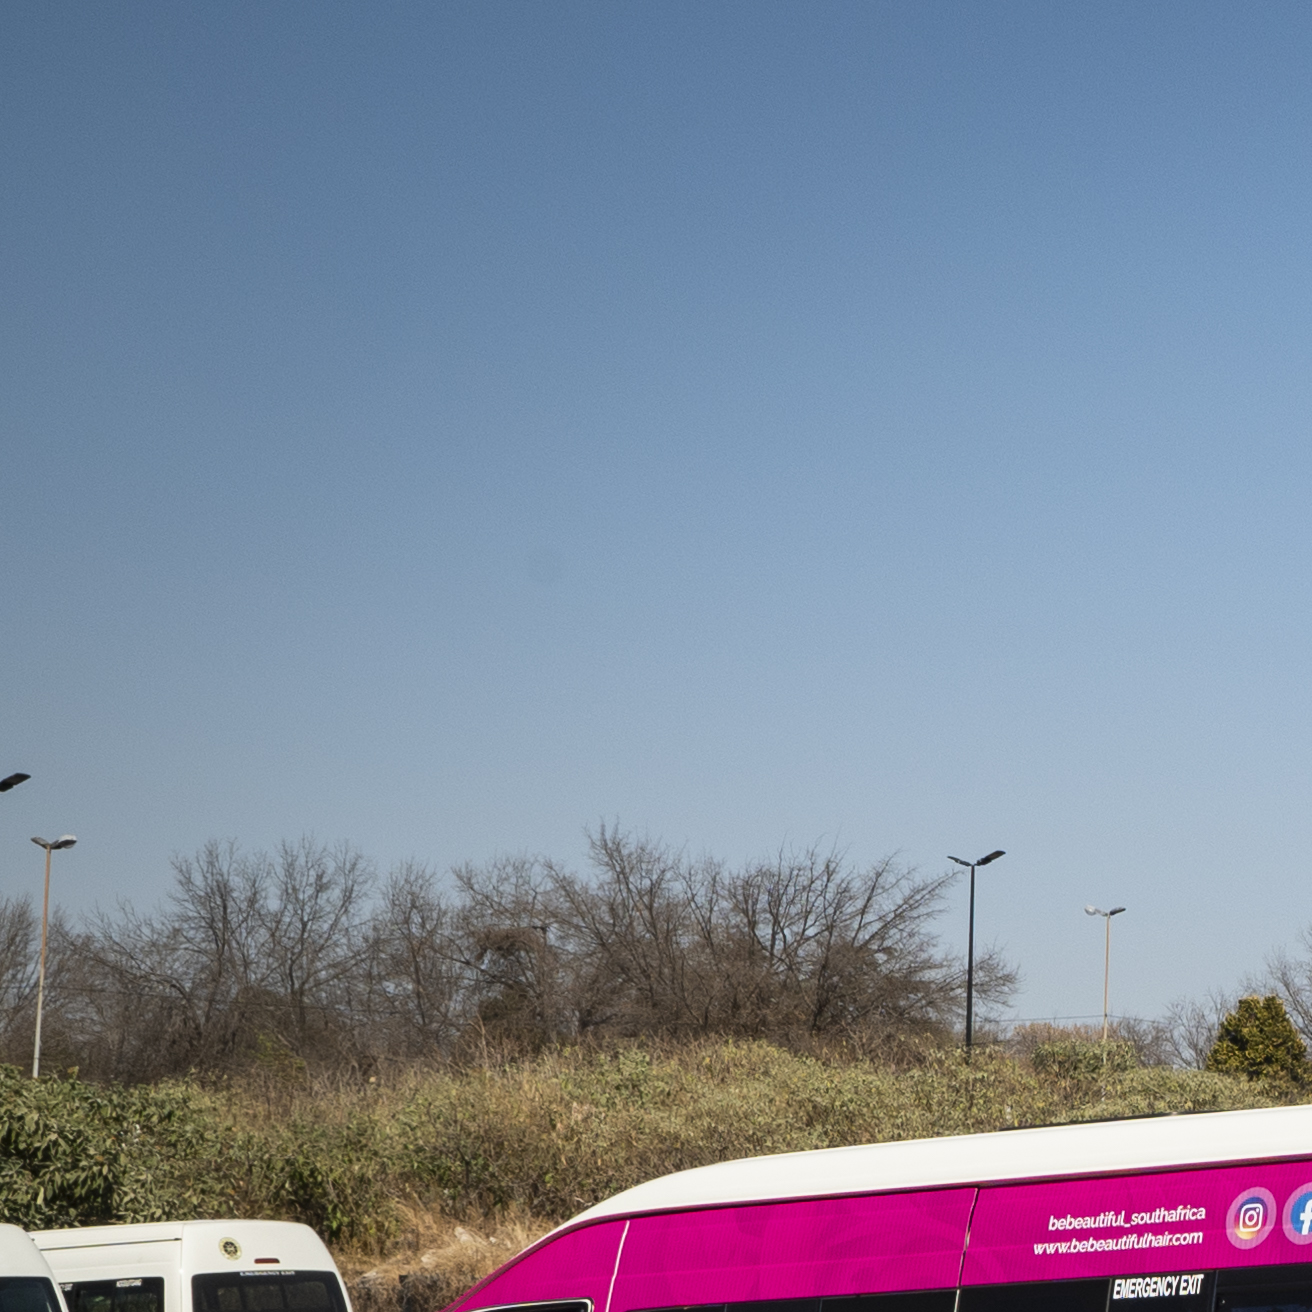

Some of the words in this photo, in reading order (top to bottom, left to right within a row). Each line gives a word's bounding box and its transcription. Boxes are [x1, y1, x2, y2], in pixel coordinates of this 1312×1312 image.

[1048, 1204, 1206, 1232] bebeautiful_southafrica
[1033, 1229, 1203, 1256] www.bebeautifulhair.com
[1113, 1276, 1177, 1300] EMERGENCY
[1179, 1274, 1204, 1296] EXIT
